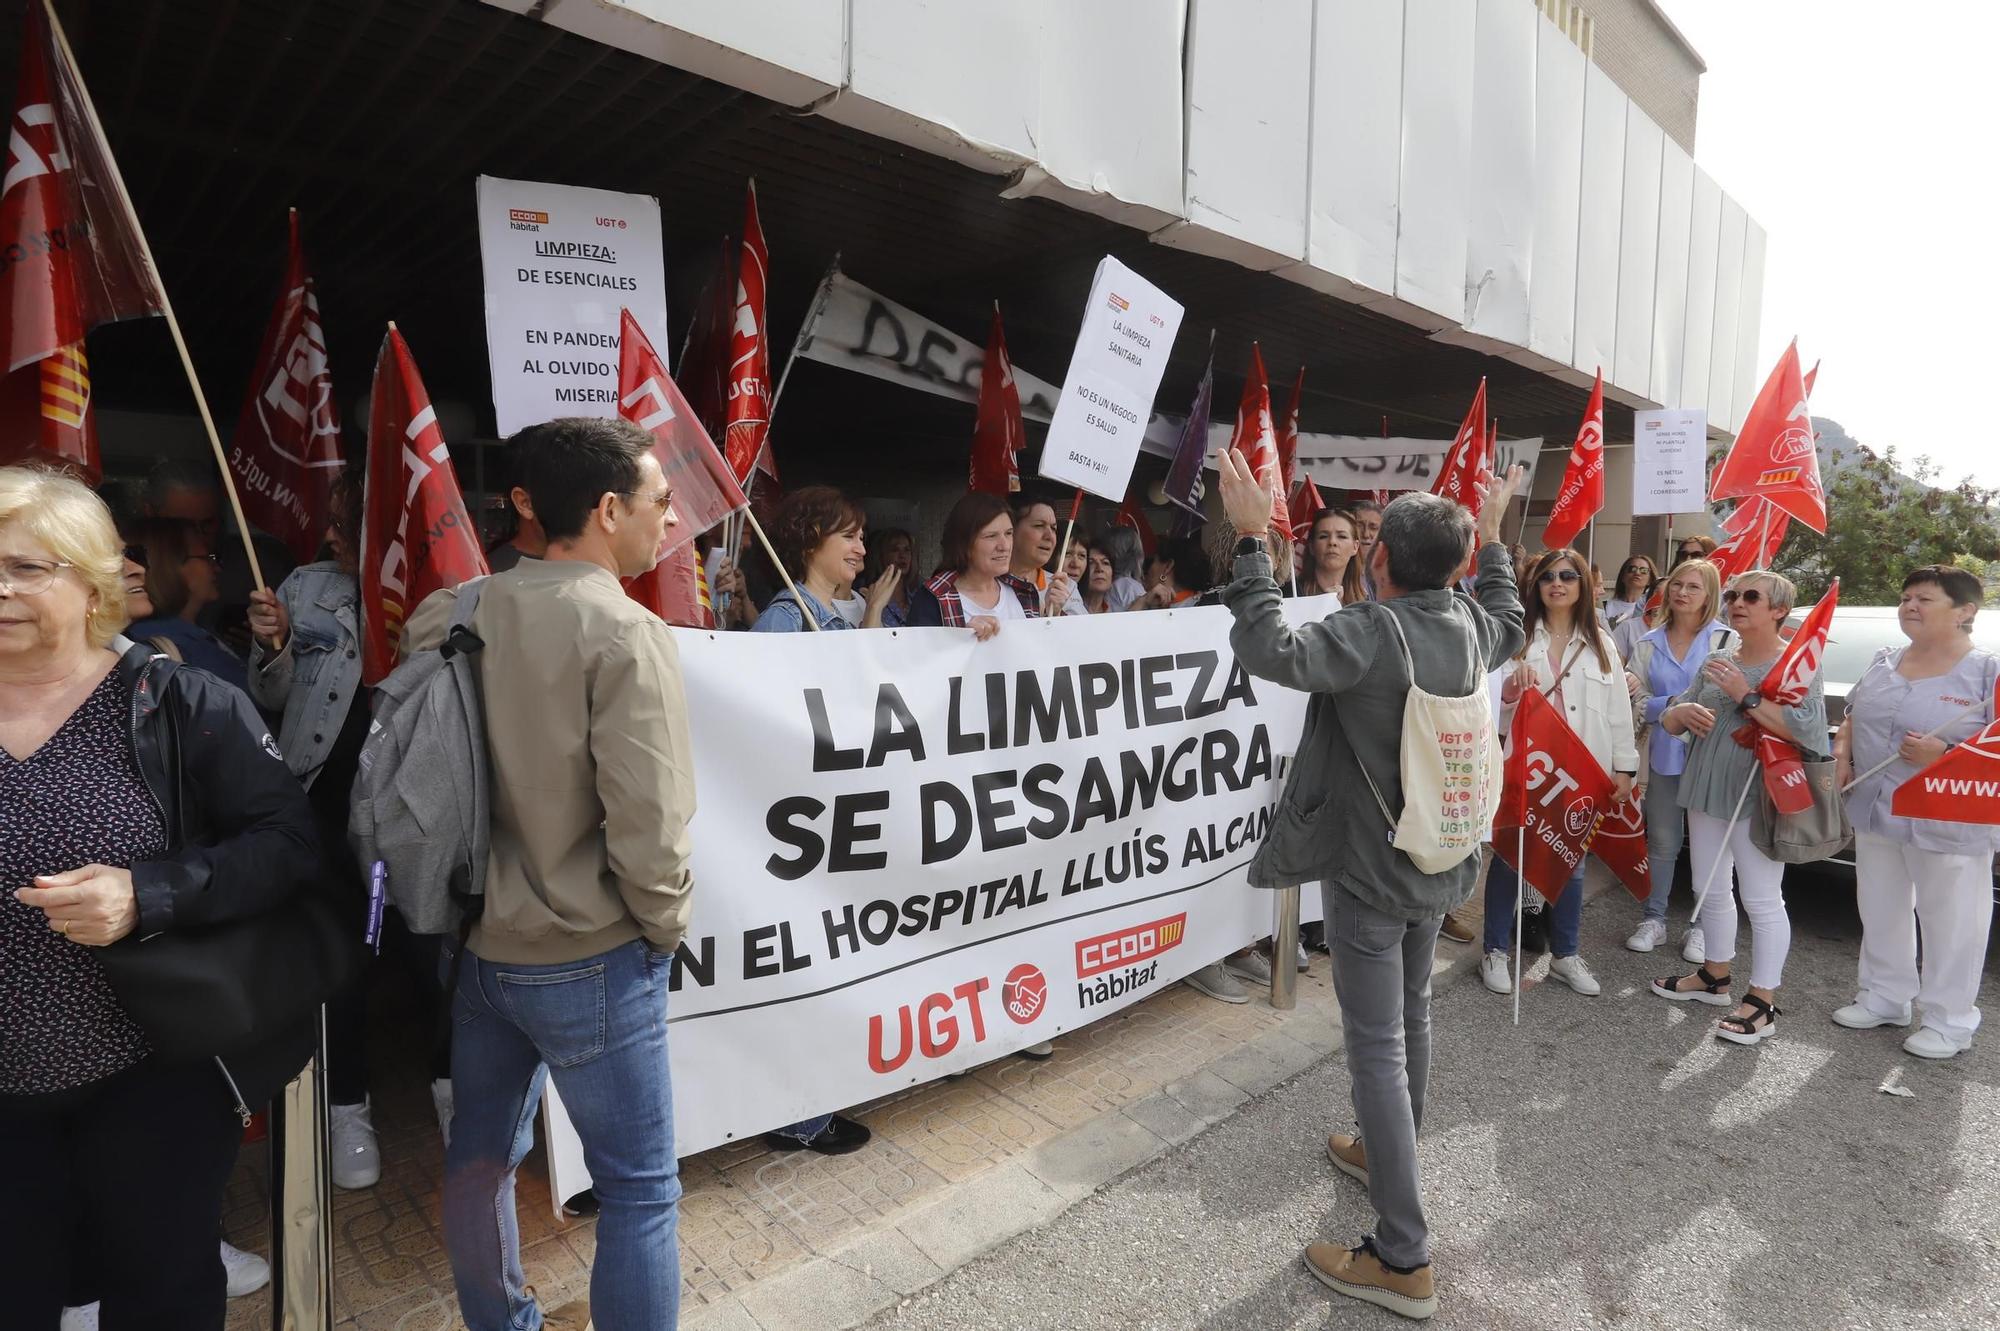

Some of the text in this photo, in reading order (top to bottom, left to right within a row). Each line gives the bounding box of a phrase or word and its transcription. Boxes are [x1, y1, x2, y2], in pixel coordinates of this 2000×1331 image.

[510, 211, 537, 222] CCOO
[595, 217, 616, 228] UGT
[535, 240, 616, 261] LIMPIEZA:
[517, 268, 637, 291] DE ESENCIALES
[1149, 313, 1160, 325] UGT
[526, 330, 548, 344] EN
[1113, 320, 1151, 349] LA LIMPIEZA
[1108, 341, 1142, 368] SANITARIA
[523, 359, 544, 374] AL
[548, 361, 610, 376] OLVIDO
[1077, 386, 1089, 398] NO
[1089, 391, 1098, 404] ES
[1099, 396, 1110, 411] UN
[1086, 413, 1118, 436] ES SALUD
[1069, 451, 1109, 476] BASTA YA!!!
[803, 650, 1258, 773] LA LIMPIEZA
[1441, 748, 1461, 759] GT
[1526, 738, 1580, 808] GT
[765, 724, 1272, 881] SE DESANGRA
[743, 921, 811, 980] EL
[823, 868, 1049, 960] HOSPITAL
[1061, 834, 1169, 897] LLUÍS
[1082, 927, 1155, 971] CCOO
[1077, 960, 1158, 1009] hàbitat
[867, 976, 989, 1074] UGT
